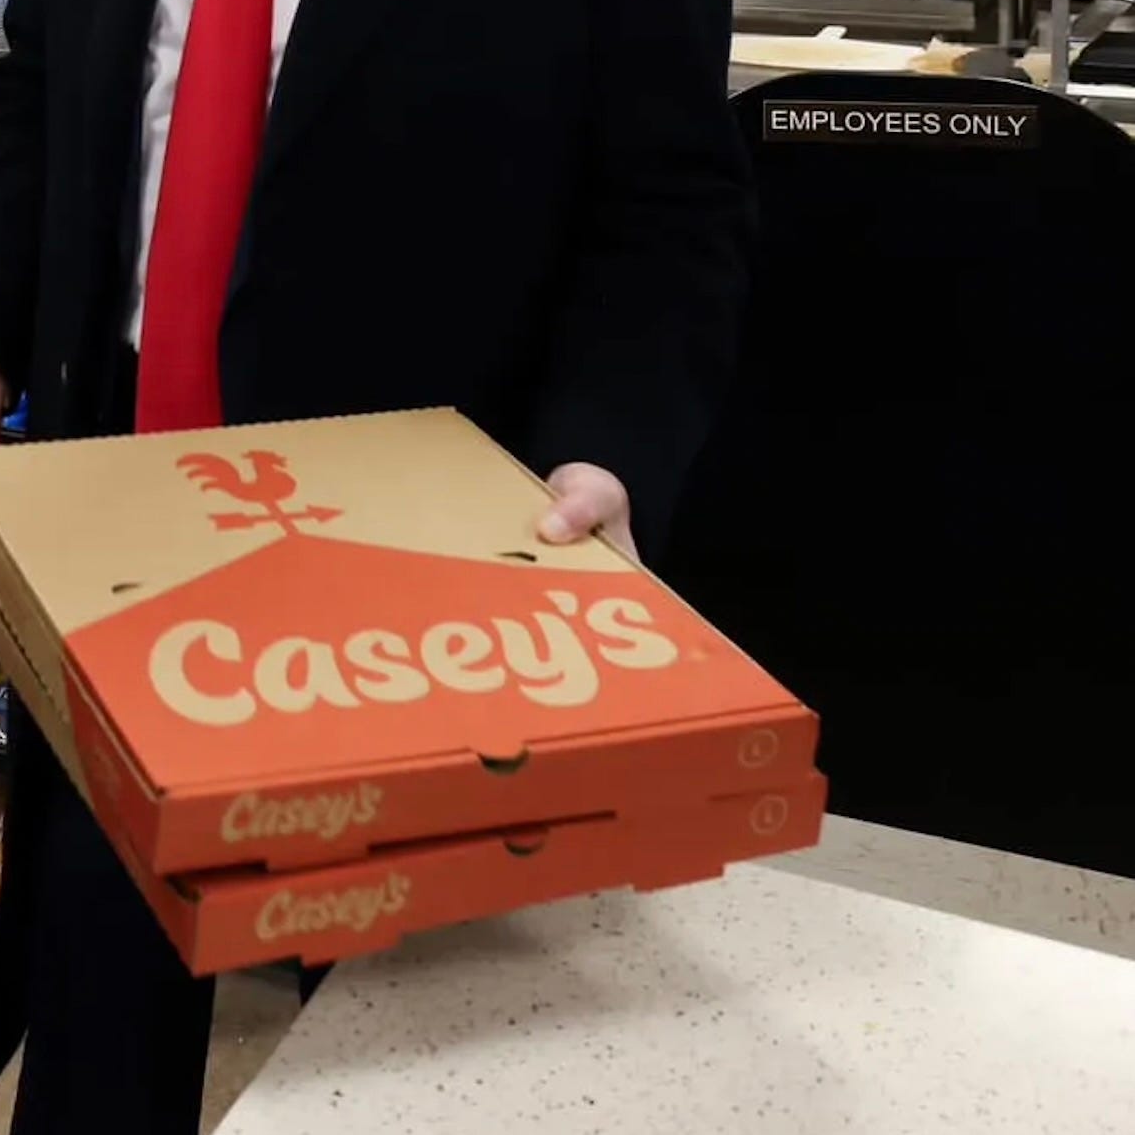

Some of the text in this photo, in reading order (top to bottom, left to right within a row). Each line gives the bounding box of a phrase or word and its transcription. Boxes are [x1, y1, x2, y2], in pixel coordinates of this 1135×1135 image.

[770, 110, 1027, 137] EMPLOYEES ONLY
[149, 590, 678, 725] Casey's
[220, 782, 383, 844] Casey's
[255, 872, 410, 941] Casey's
